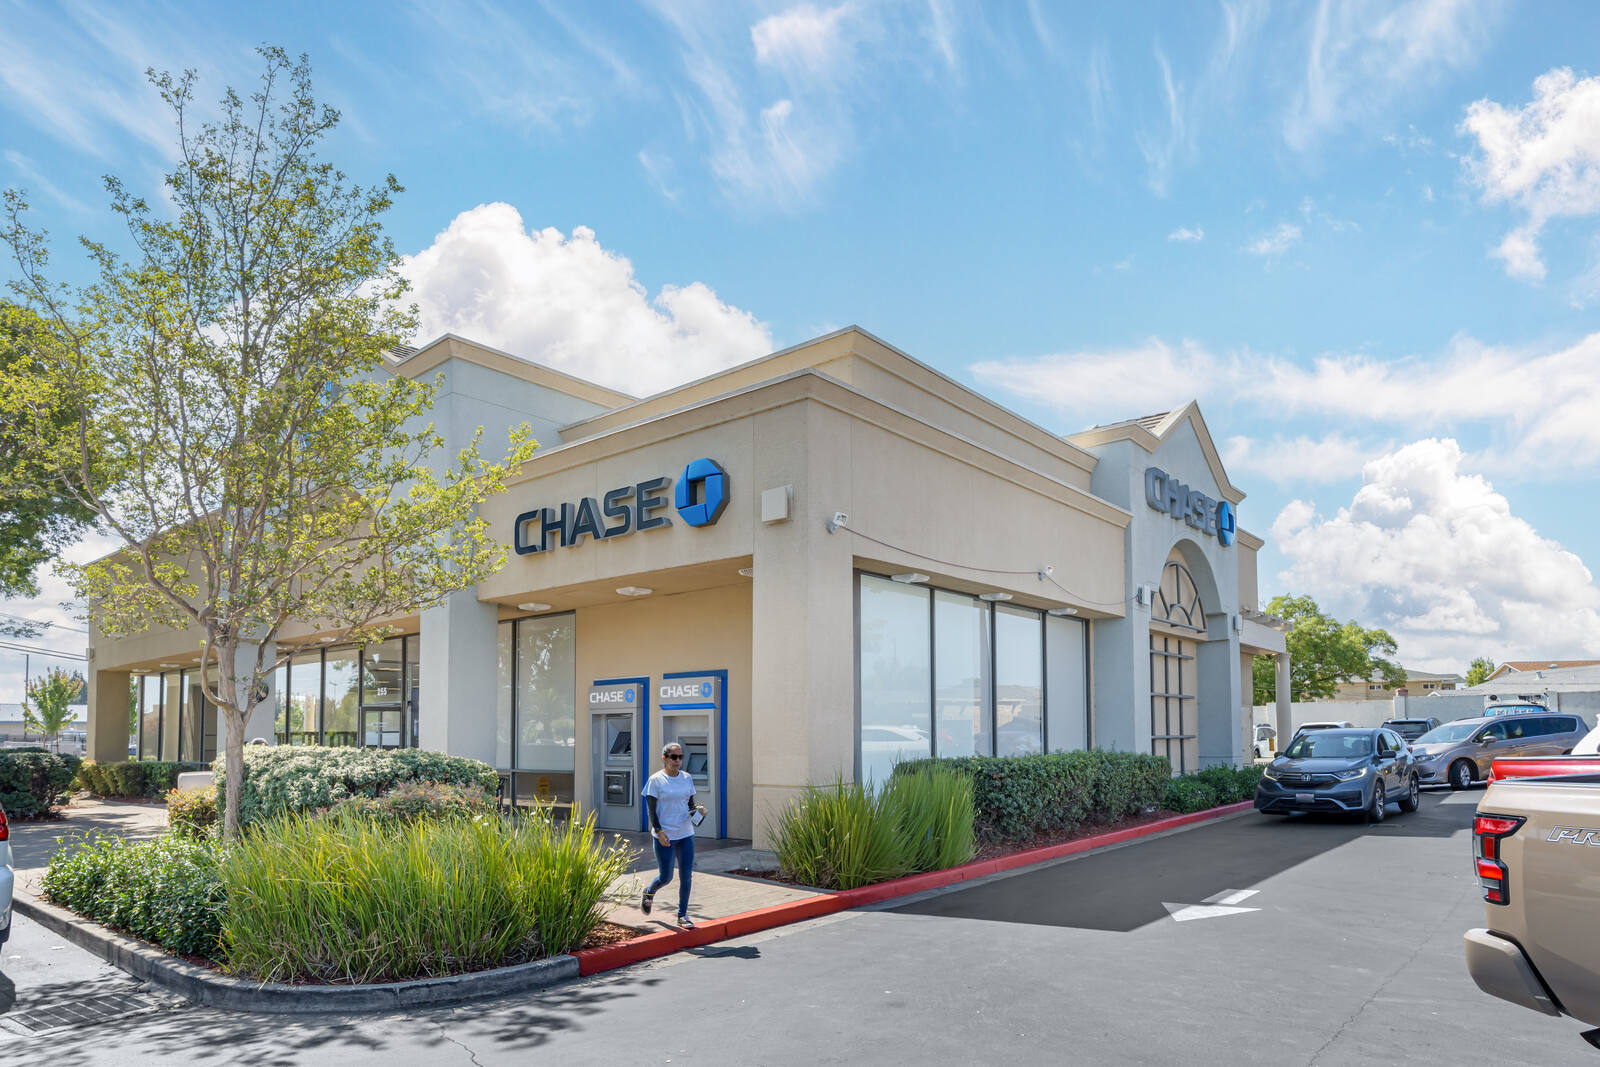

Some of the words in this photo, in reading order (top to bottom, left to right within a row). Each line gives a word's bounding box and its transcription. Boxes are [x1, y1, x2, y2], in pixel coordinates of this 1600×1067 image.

[514, 477, 673, 556] CHASE
[1144, 467, 1217, 536] CHASE
[589, 690, 624, 703] CHASE
[659, 684, 700, 698] CHASE
